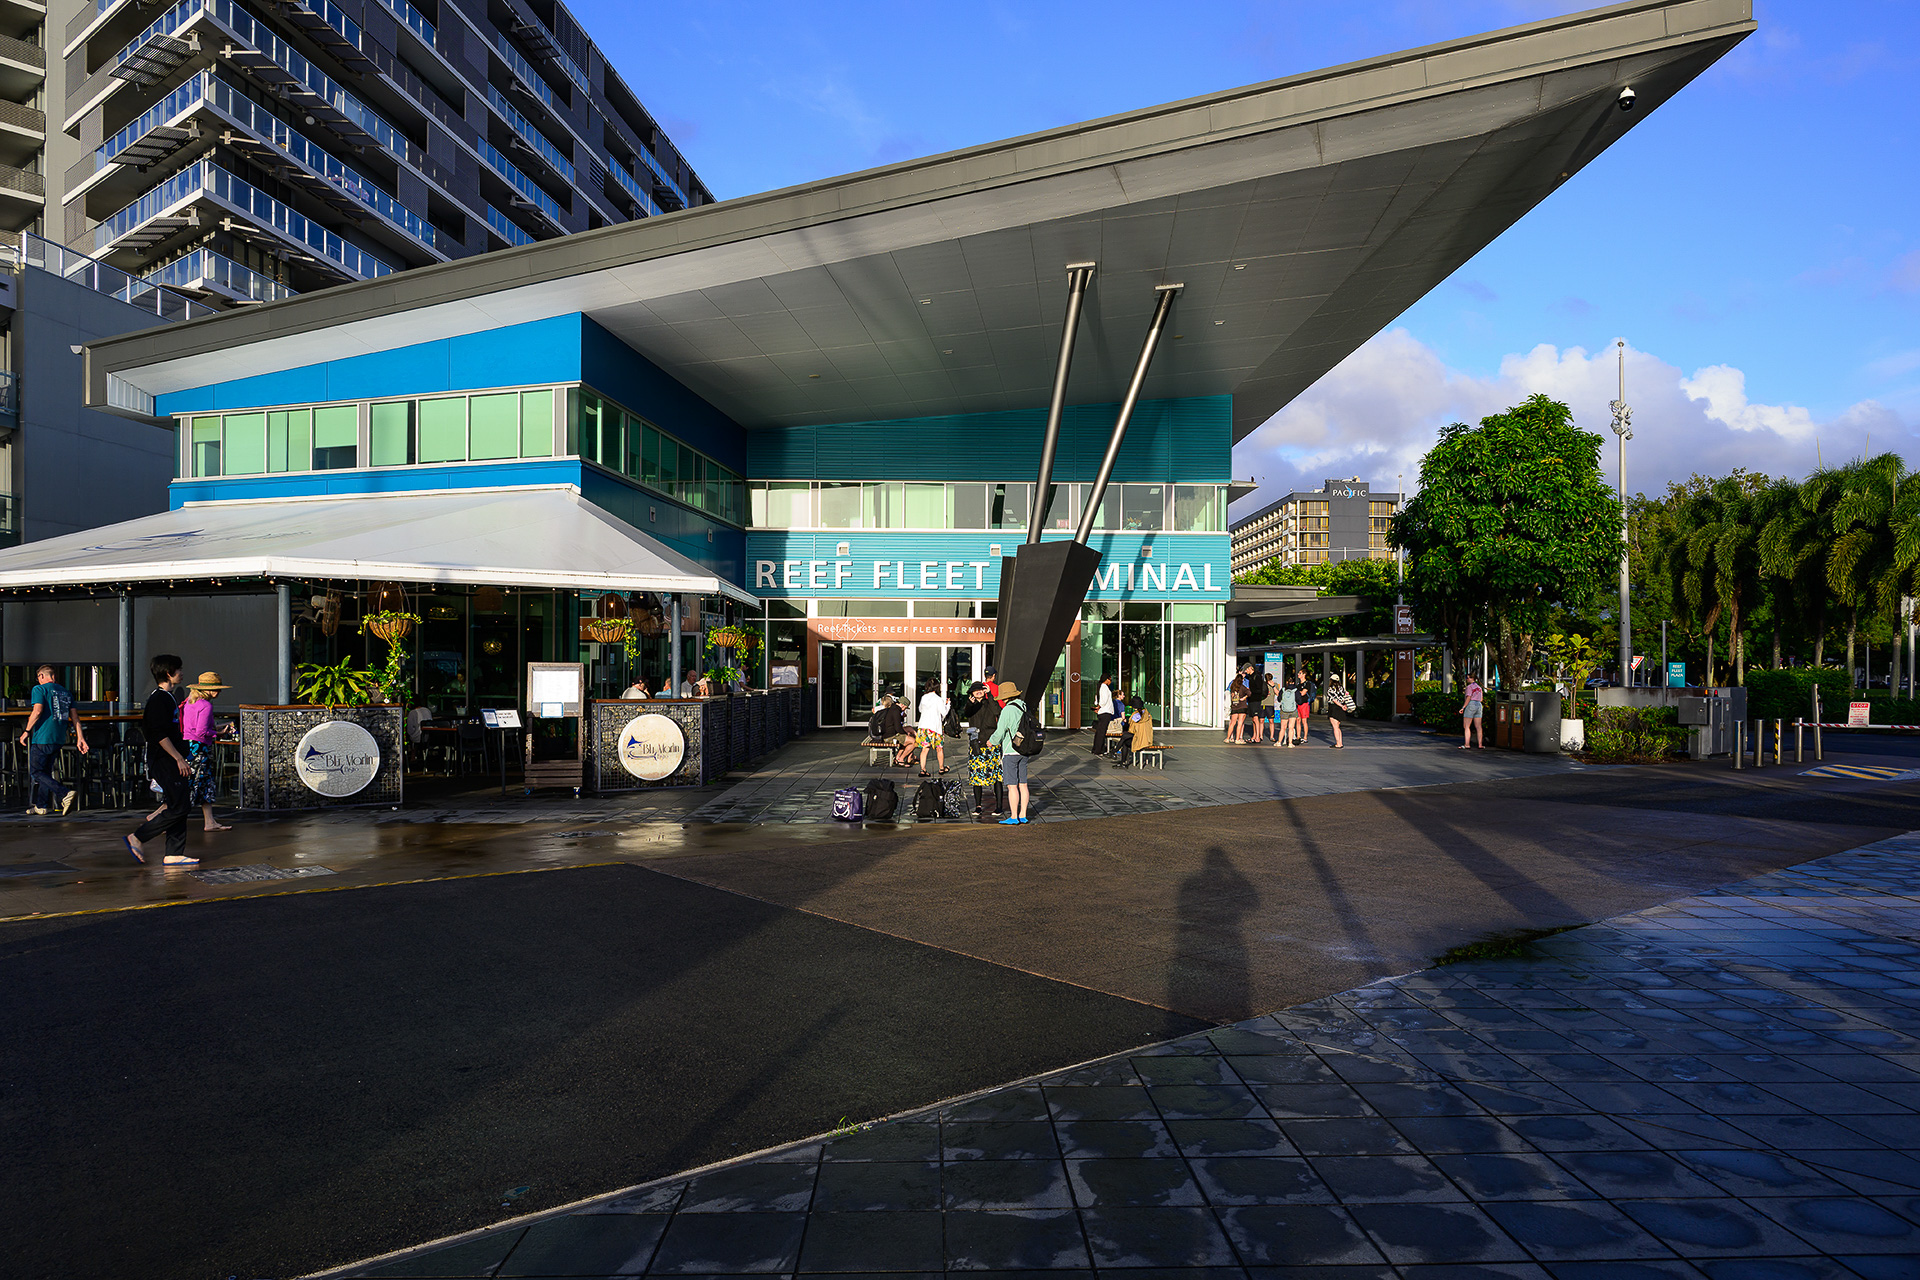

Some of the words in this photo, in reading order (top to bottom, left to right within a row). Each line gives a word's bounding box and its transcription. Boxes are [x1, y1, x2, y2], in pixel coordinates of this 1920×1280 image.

[1332, 487, 1367, 498] PACIFIC
[756, 560, 853, 589] REEF
[873, 560, 991, 590] FLEET
[1088, 562, 1222, 592] MINAL
[883, 626, 909, 634] REEF
[912, 626, 944, 634] FLEET
[1407, 651, 1411, 660] 1
[658, 743, 680, 754] Marlin
[346, 753, 373, 766] Marlin
